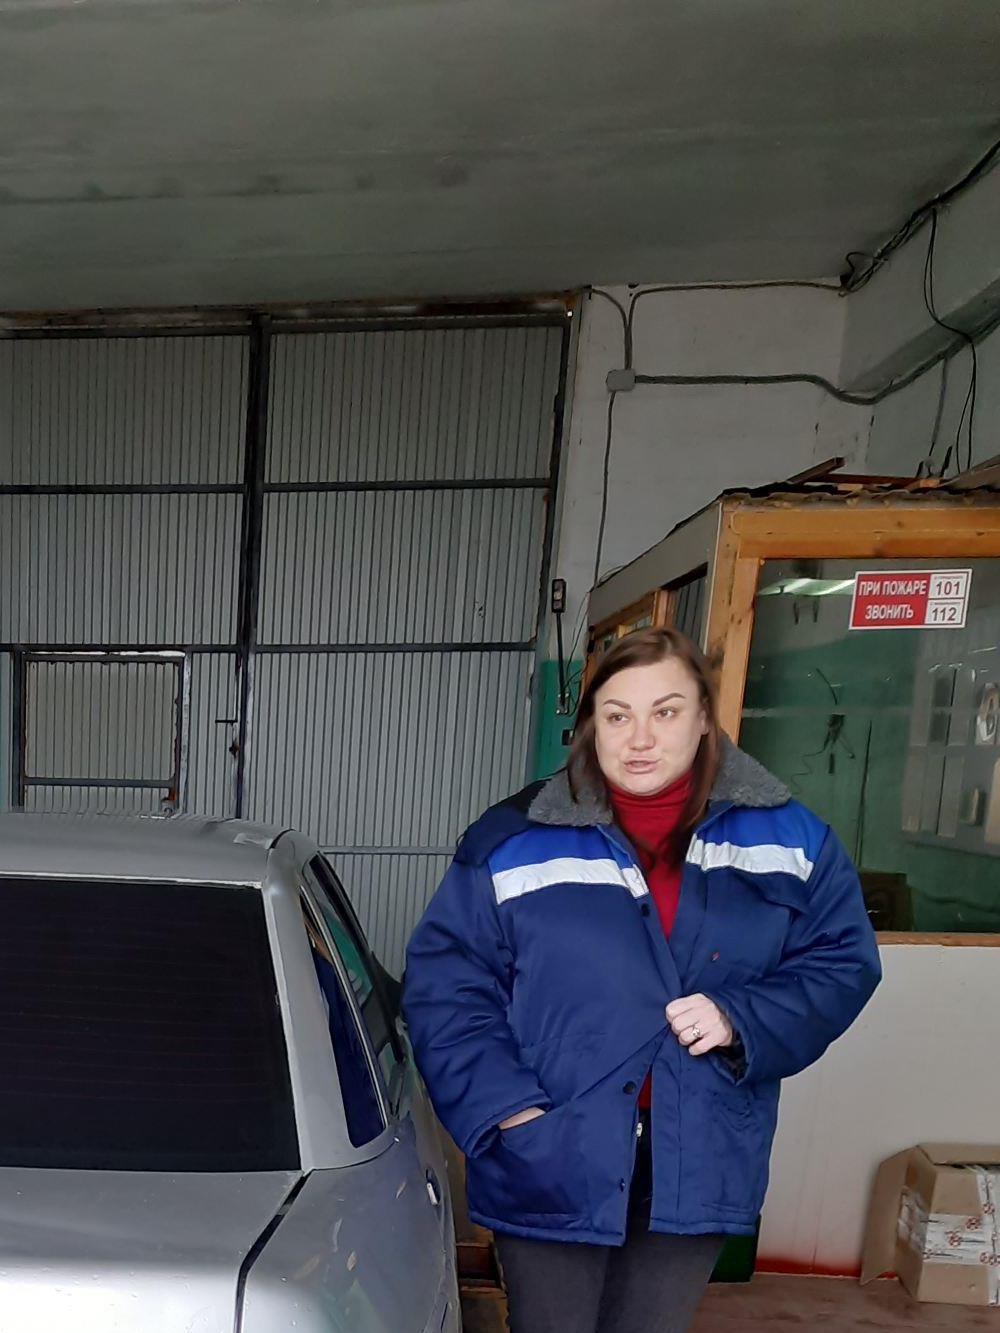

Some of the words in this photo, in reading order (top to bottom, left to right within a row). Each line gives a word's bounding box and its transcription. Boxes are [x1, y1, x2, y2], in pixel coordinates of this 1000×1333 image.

[858, 580, 881, 596] ПРИ
[882, 580, 927, 596] ПОЖАРЕ
[936, 581, 961, 596] 101
[864, 604, 914, 620] ЗВОНИТЬ
[932, 606, 957, 621] 112
